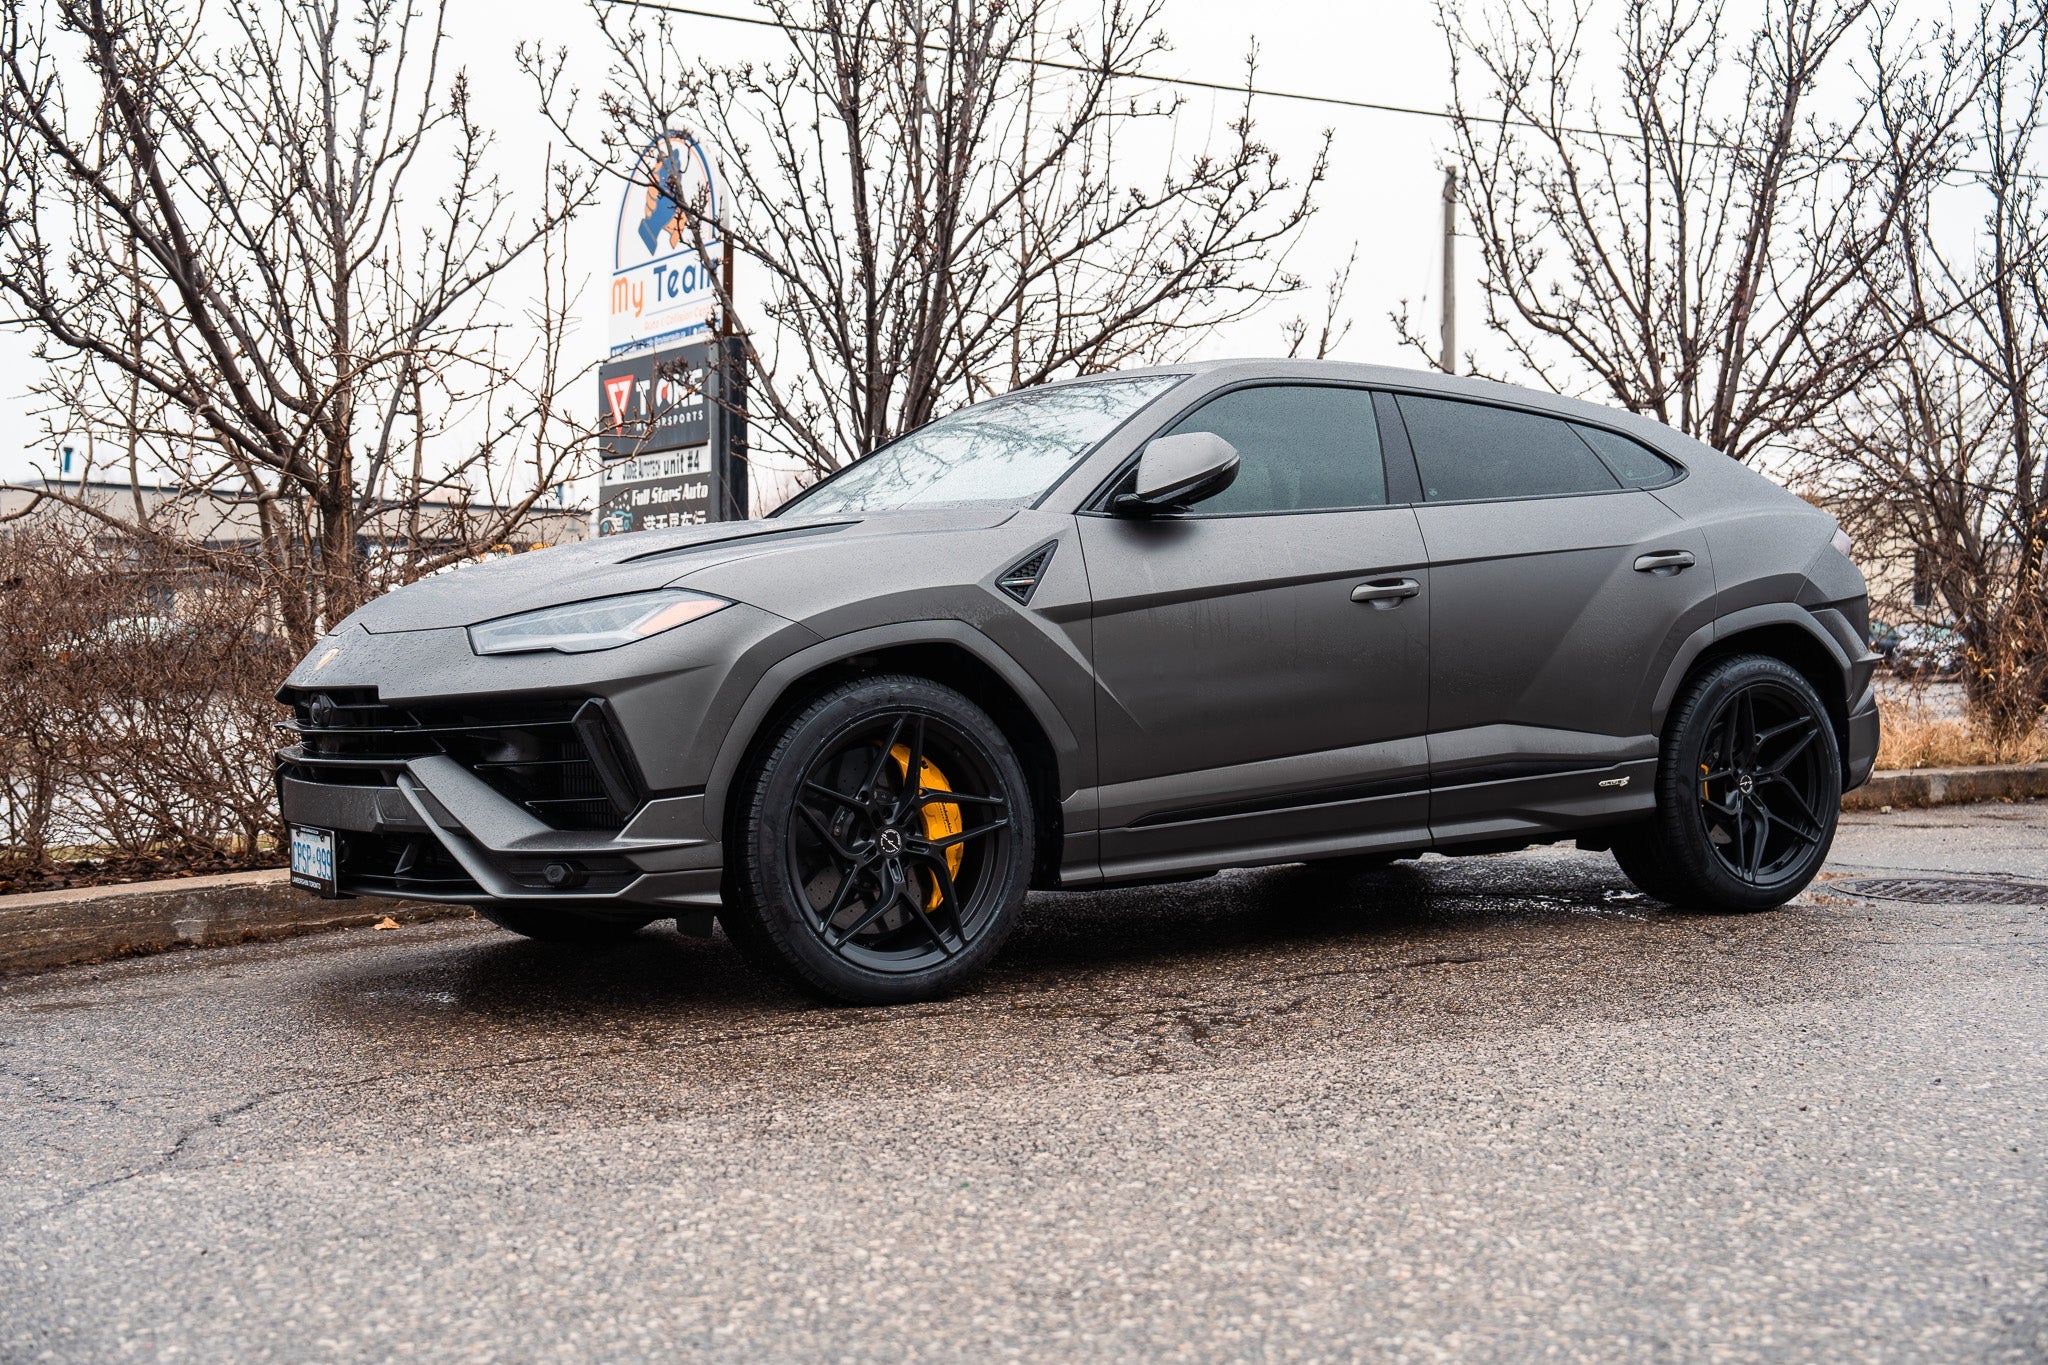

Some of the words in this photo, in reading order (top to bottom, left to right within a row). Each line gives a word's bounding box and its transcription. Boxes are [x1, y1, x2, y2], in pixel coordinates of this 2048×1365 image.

[663, 453, 684, 476] unit
[631, 488, 650, 507] Full
[682, 481, 709, 501] Auto
